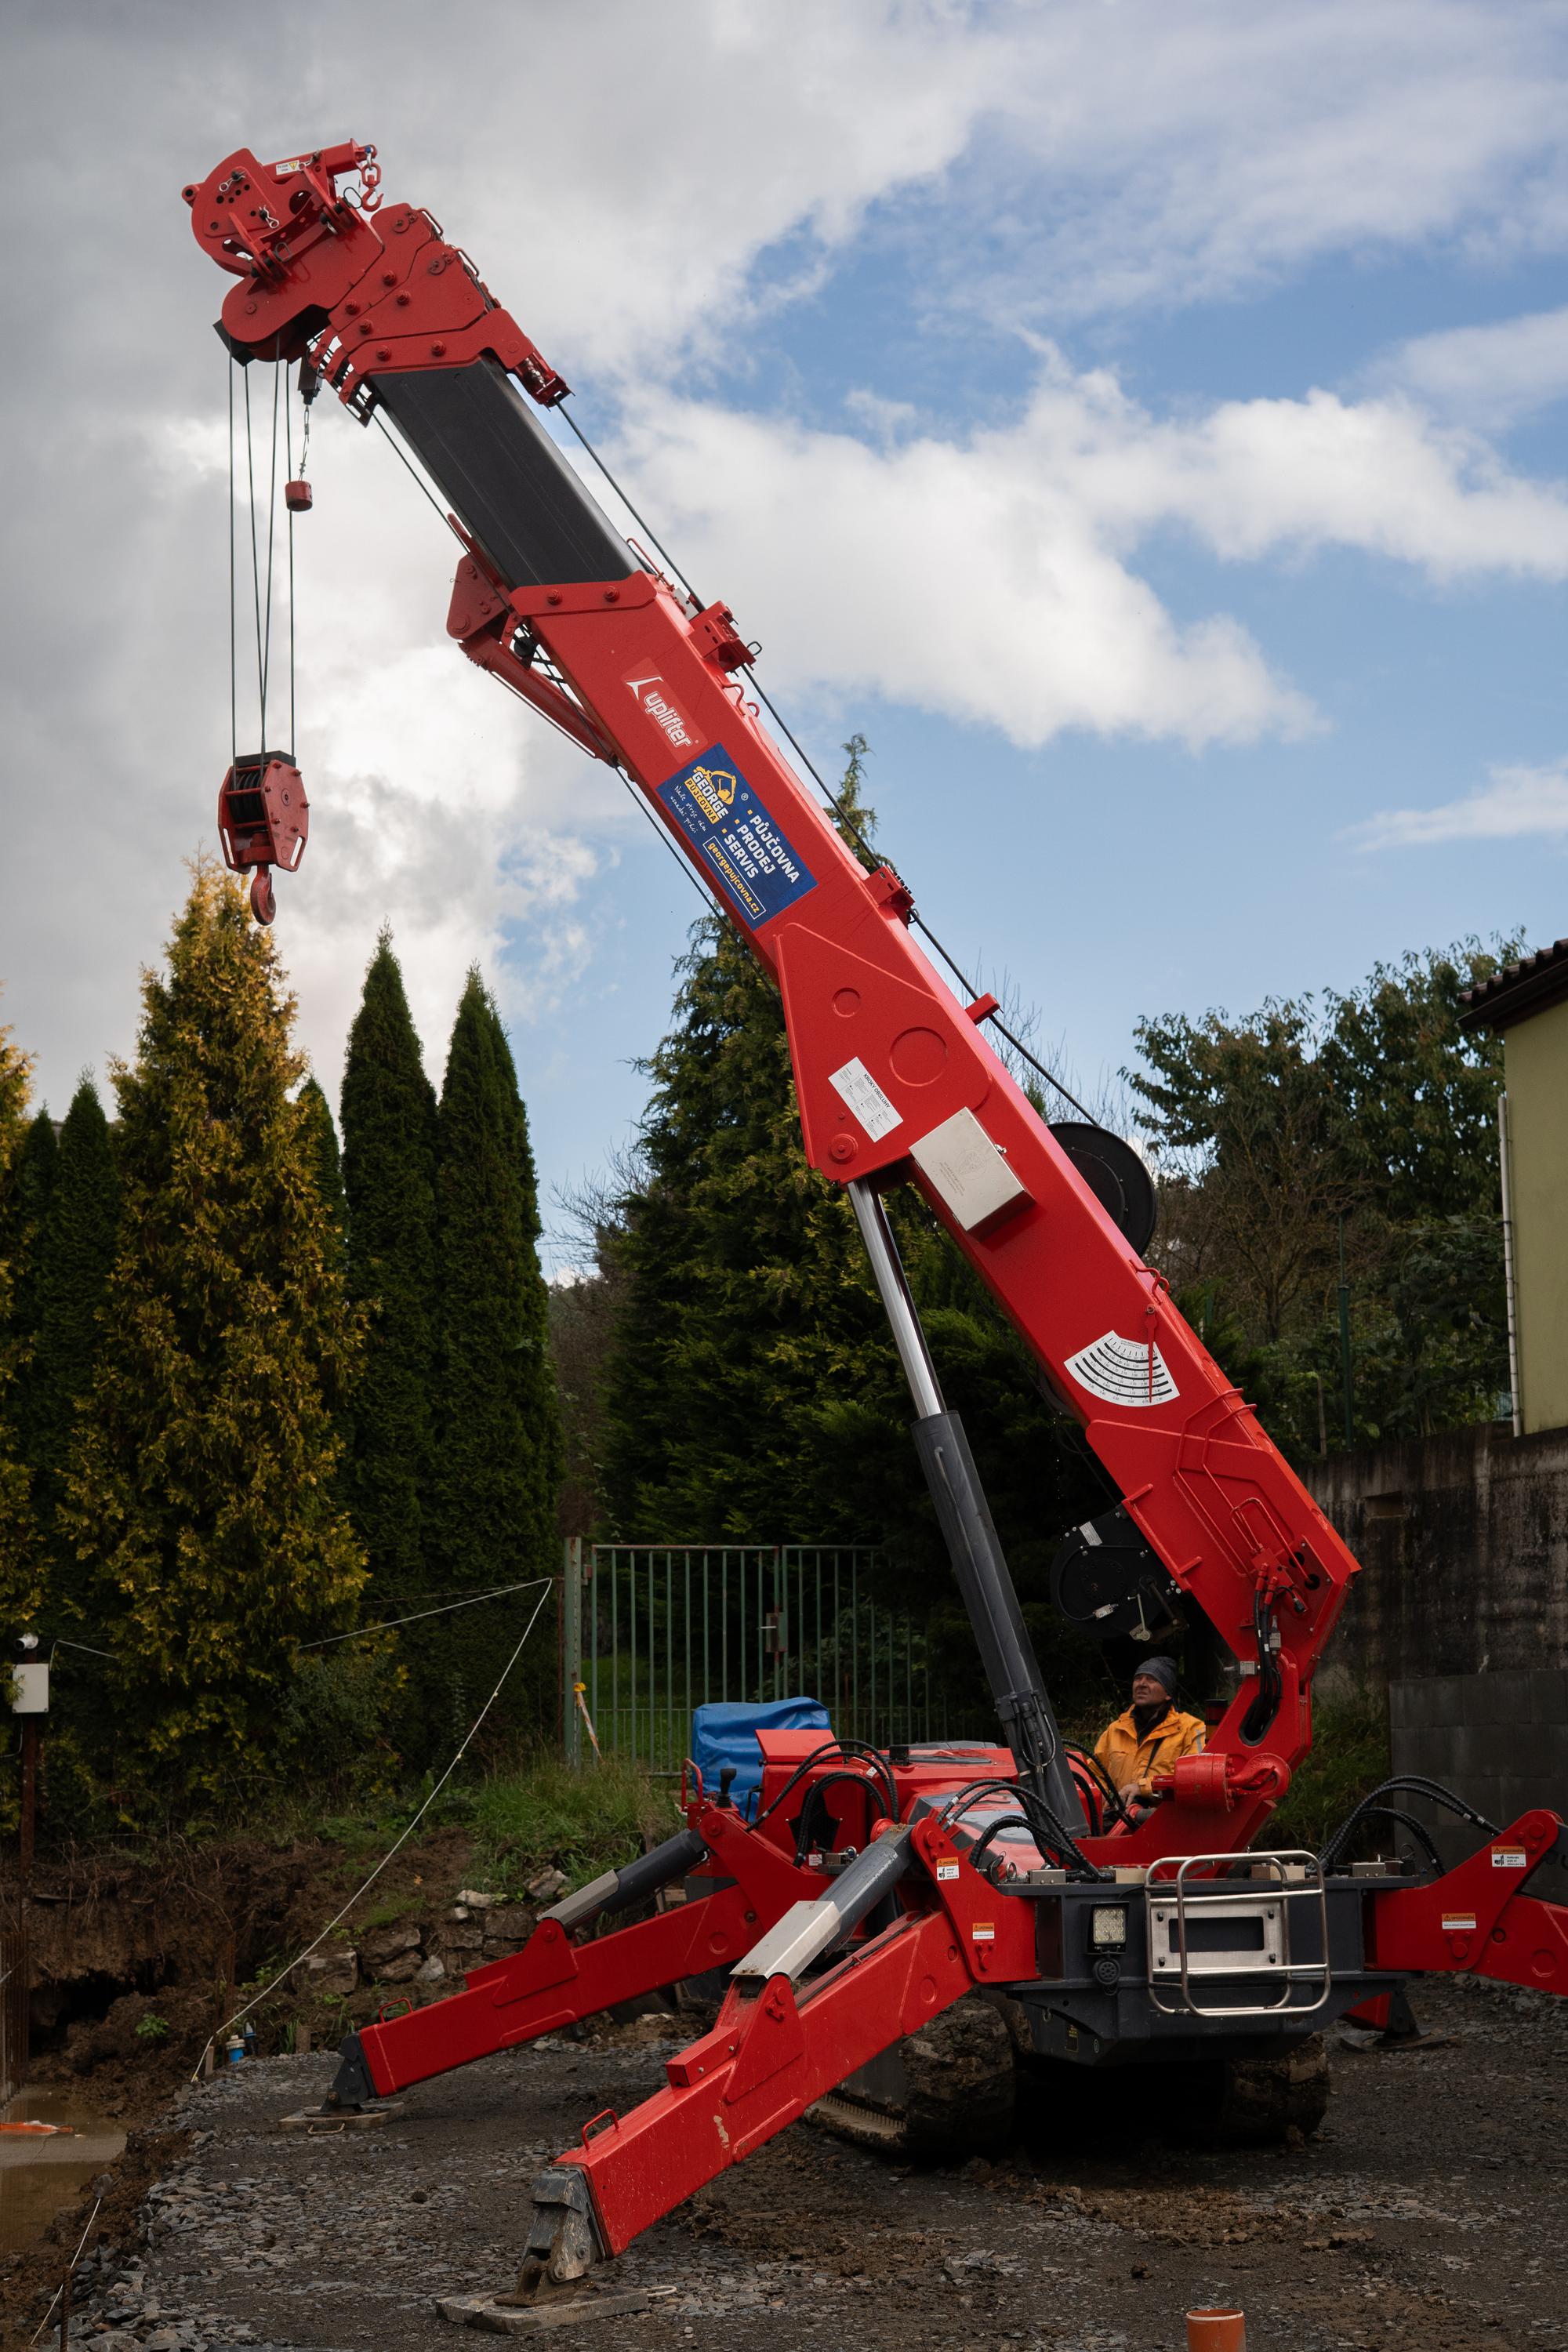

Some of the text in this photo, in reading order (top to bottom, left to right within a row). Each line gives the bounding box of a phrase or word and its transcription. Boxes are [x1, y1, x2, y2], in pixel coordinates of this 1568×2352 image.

[644, 691, 692, 748] uplifter
[685, 802, 698, 818] stroje
[692, 771, 729, 819] GEORGE
[684, 817, 698, 833] práci
[737, 824, 776, 874] PRODEJ
[724, 833, 759, 879] SERVIS
[750, 815, 800, 884] PŮJČOVNA
[707, 842, 760, 913] georgepujcovna.cz
[863, 1073, 877, 1088] KROKY
[874, 1087, 891, 1109] OBSLUHY
